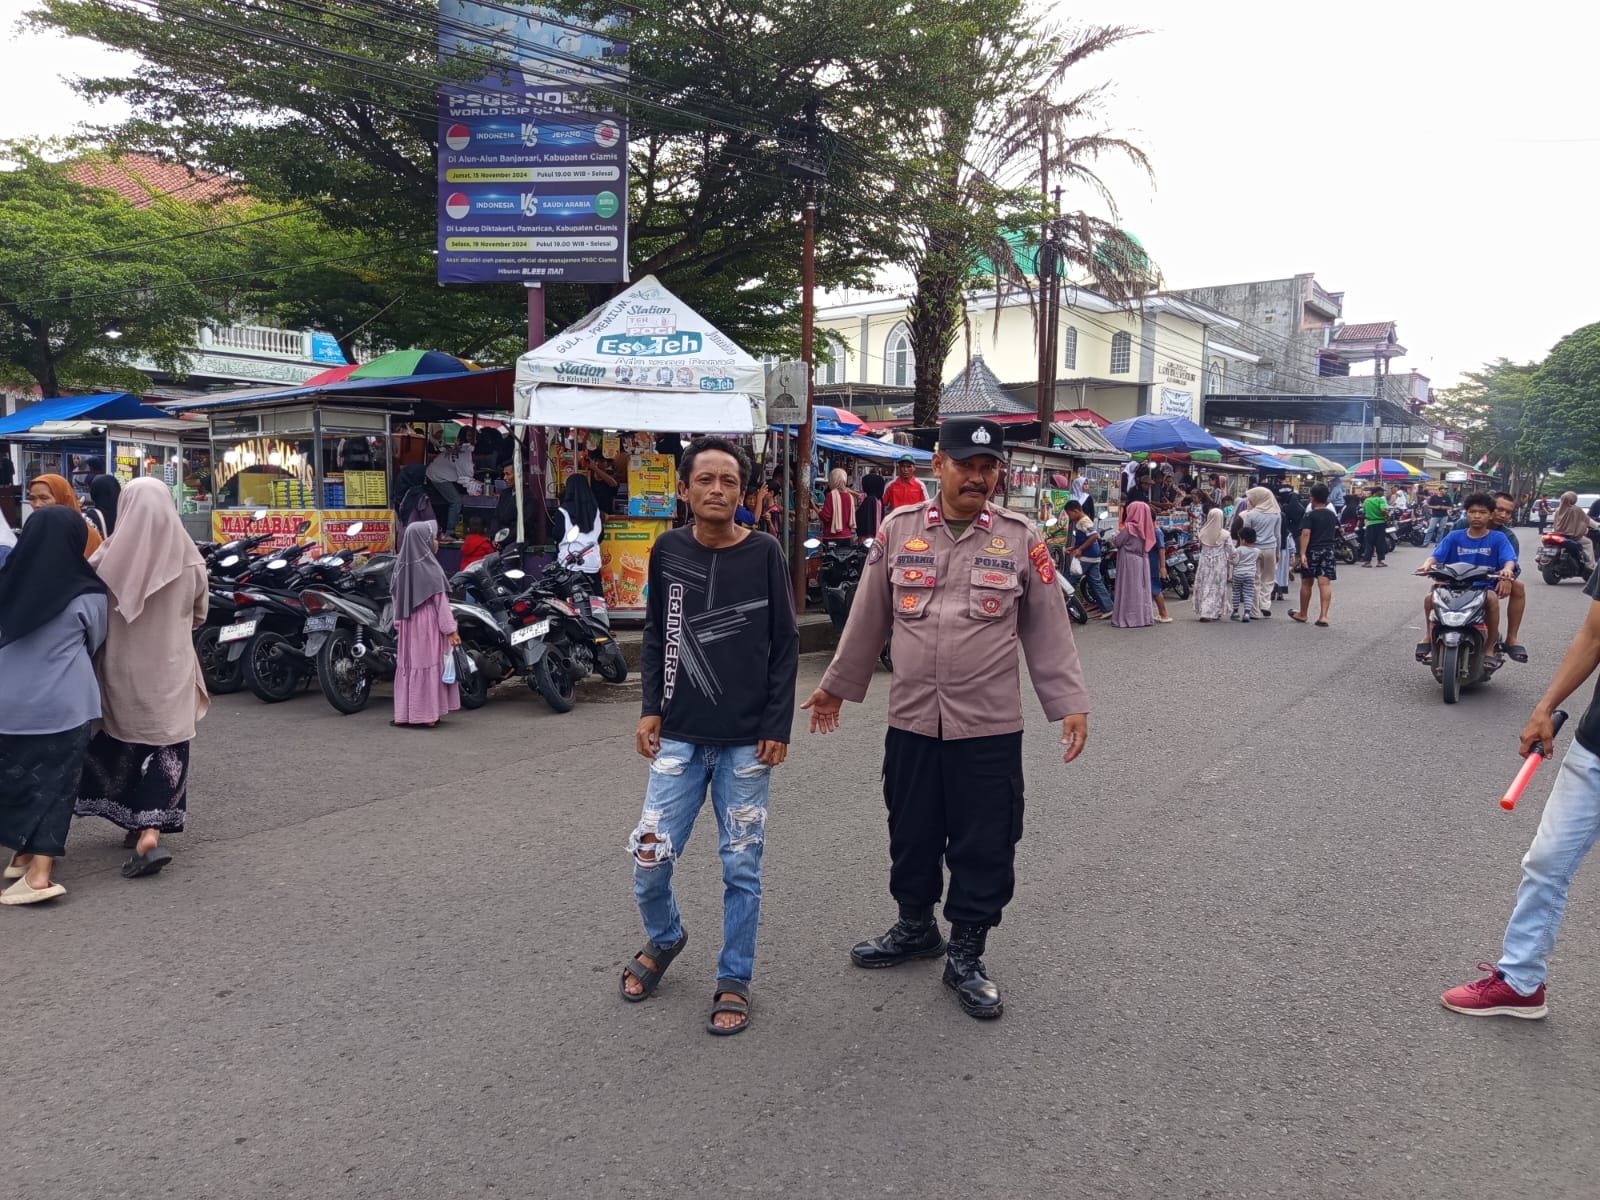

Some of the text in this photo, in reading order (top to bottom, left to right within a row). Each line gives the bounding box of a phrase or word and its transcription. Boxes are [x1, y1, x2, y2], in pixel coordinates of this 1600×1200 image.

[449, 107, 499, 117] WORLD
[501, 106, 530, 116] CUP
[476, 121, 581, 148] INDONESIA VS JEPANG
[448, 152, 619, 165] Di Alun-Alun Banjarsari, Kabupaten Ciamis
[481, 171, 511, 179] November
[537, 171, 554, 179] Pukul
[573, 170, 587, 178] WIB
[592, 170, 613, 178] Selesai
[476, 192, 591, 217] INDONESIA VS SAUDI ARABIA
[446, 225, 454, 233] Di
[455, 225, 480, 234] Lapang
[517, 225, 554, 233] Pamarican,
[555, 224, 593, 233] Kabupaten
[594, 223, 618, 232] Ciamis
[481, 240, 511, 248] November
[512, 240, 528, 248] 2024
[536, 240, 553, 248] Pukul
[572, 240, 585, 248] WIB
[590, 239, 612, 247] Selesai
[627, 304, 671, 316] Station
[556, 299, 631, 354] GULA PREMIUM
[601, 335, 699, 355] Es Teh
[553, 361, 607, 378] Station
[567, 375, 591, 384] Kristal
[327, 522, 390, 533] MARABAK
[974, 556, 1016, 570] POLRI
[663, 583, 684, 700] CONVERSE
